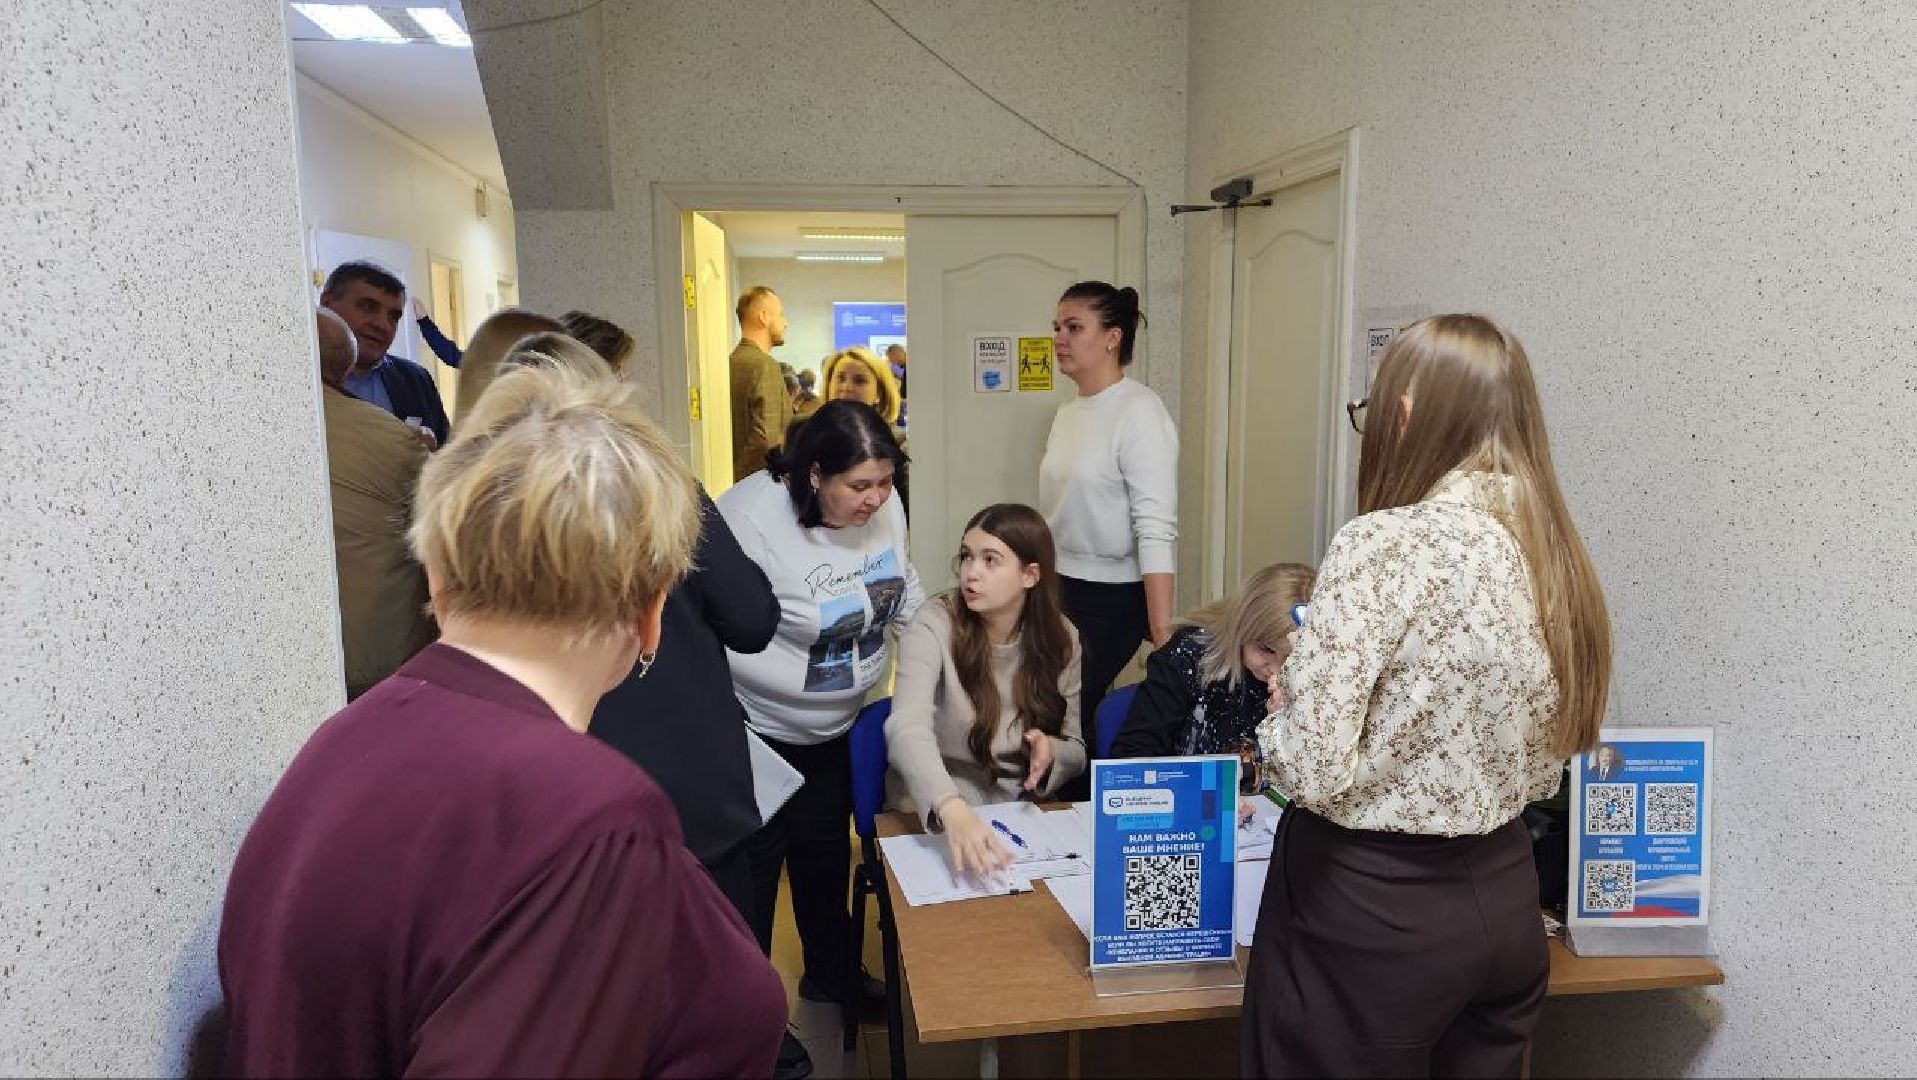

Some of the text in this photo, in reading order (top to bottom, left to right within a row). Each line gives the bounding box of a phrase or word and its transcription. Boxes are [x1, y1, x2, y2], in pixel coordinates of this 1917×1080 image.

[979, 341, 1006, 352] ВХОД
[804, 553, 884, 599] Remember
[1129, 831, 1196, 843] НАМ ВАЖНО
[1122, 842, 1205, 854] ВАШЕ МНЕНИЕ!
